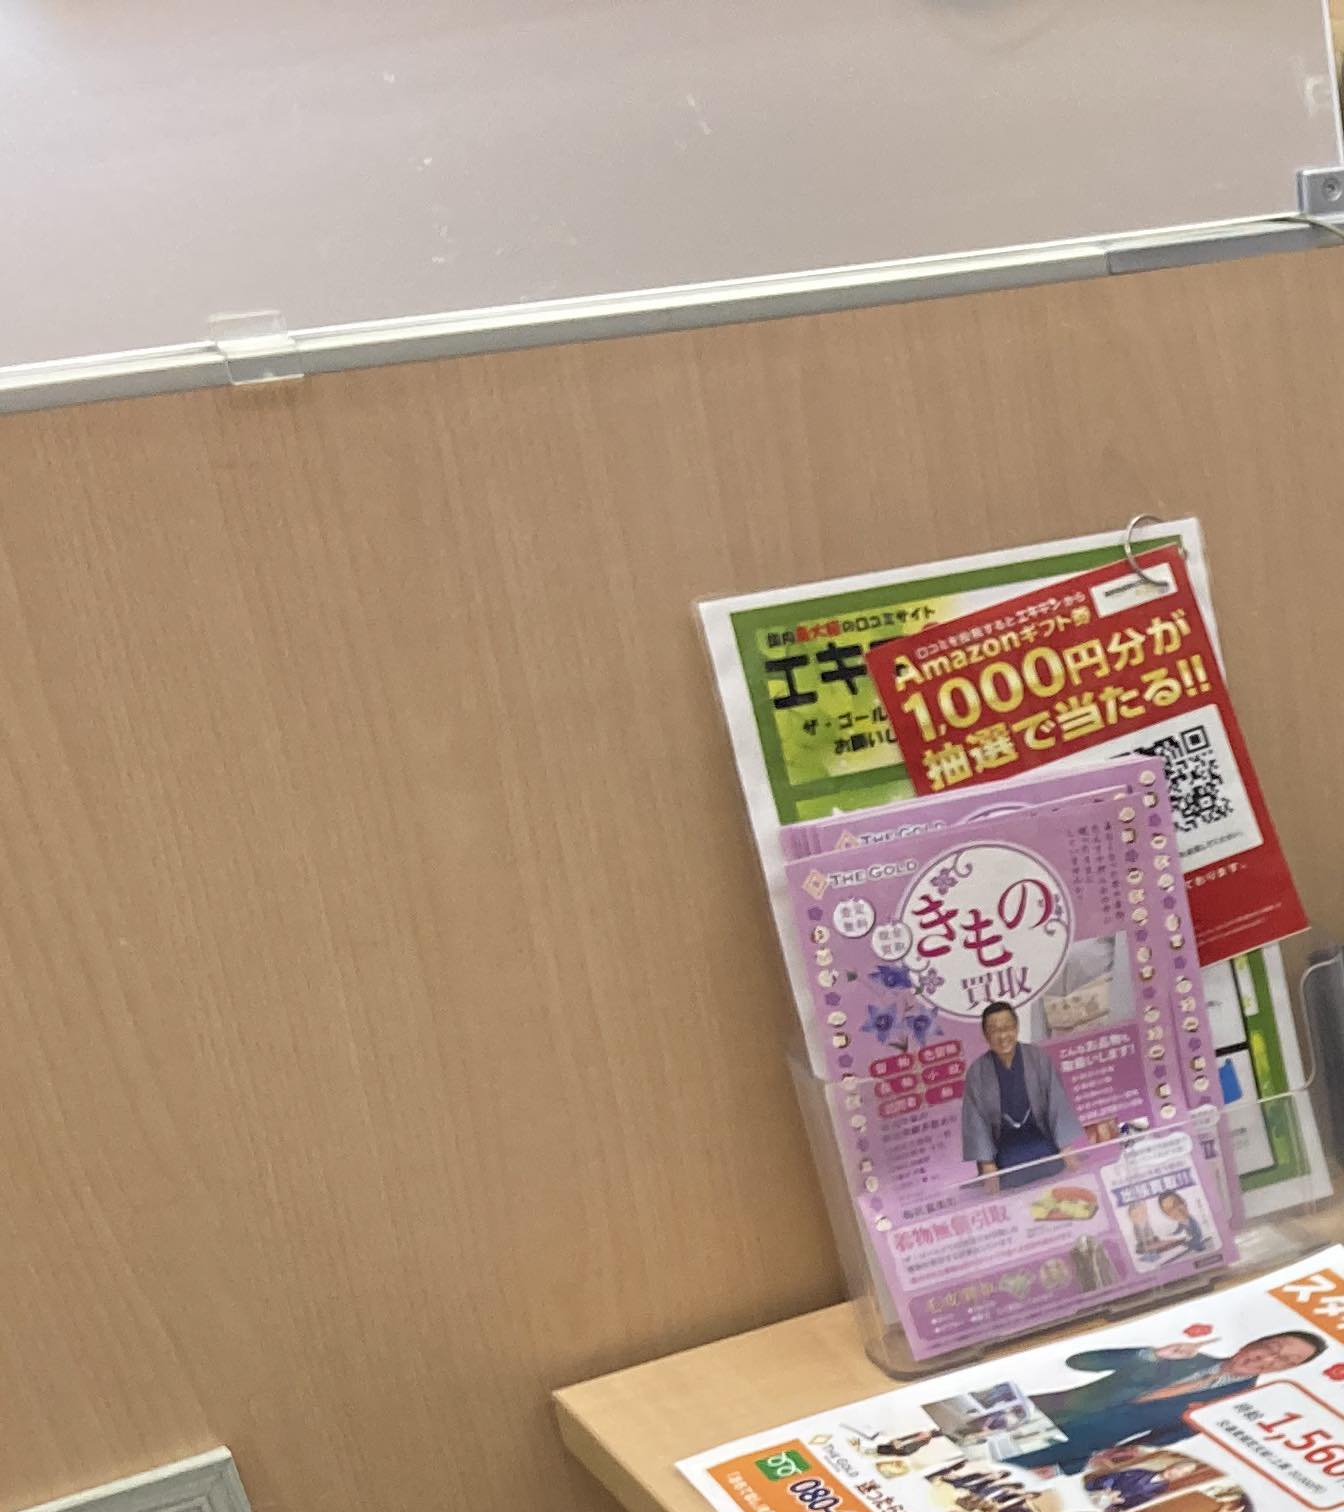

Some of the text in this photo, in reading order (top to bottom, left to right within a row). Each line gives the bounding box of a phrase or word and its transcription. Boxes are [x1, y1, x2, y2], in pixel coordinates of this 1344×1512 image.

[903, 608, 1193, 743] 1,000円分が
[922, 655, 1212, 792] 抽選で当たる!!
[828, 853, 921, 889] THE GOLD
[905, 867, 1064, 983] きもの
[959, 962, 1033, 1011] 買取
